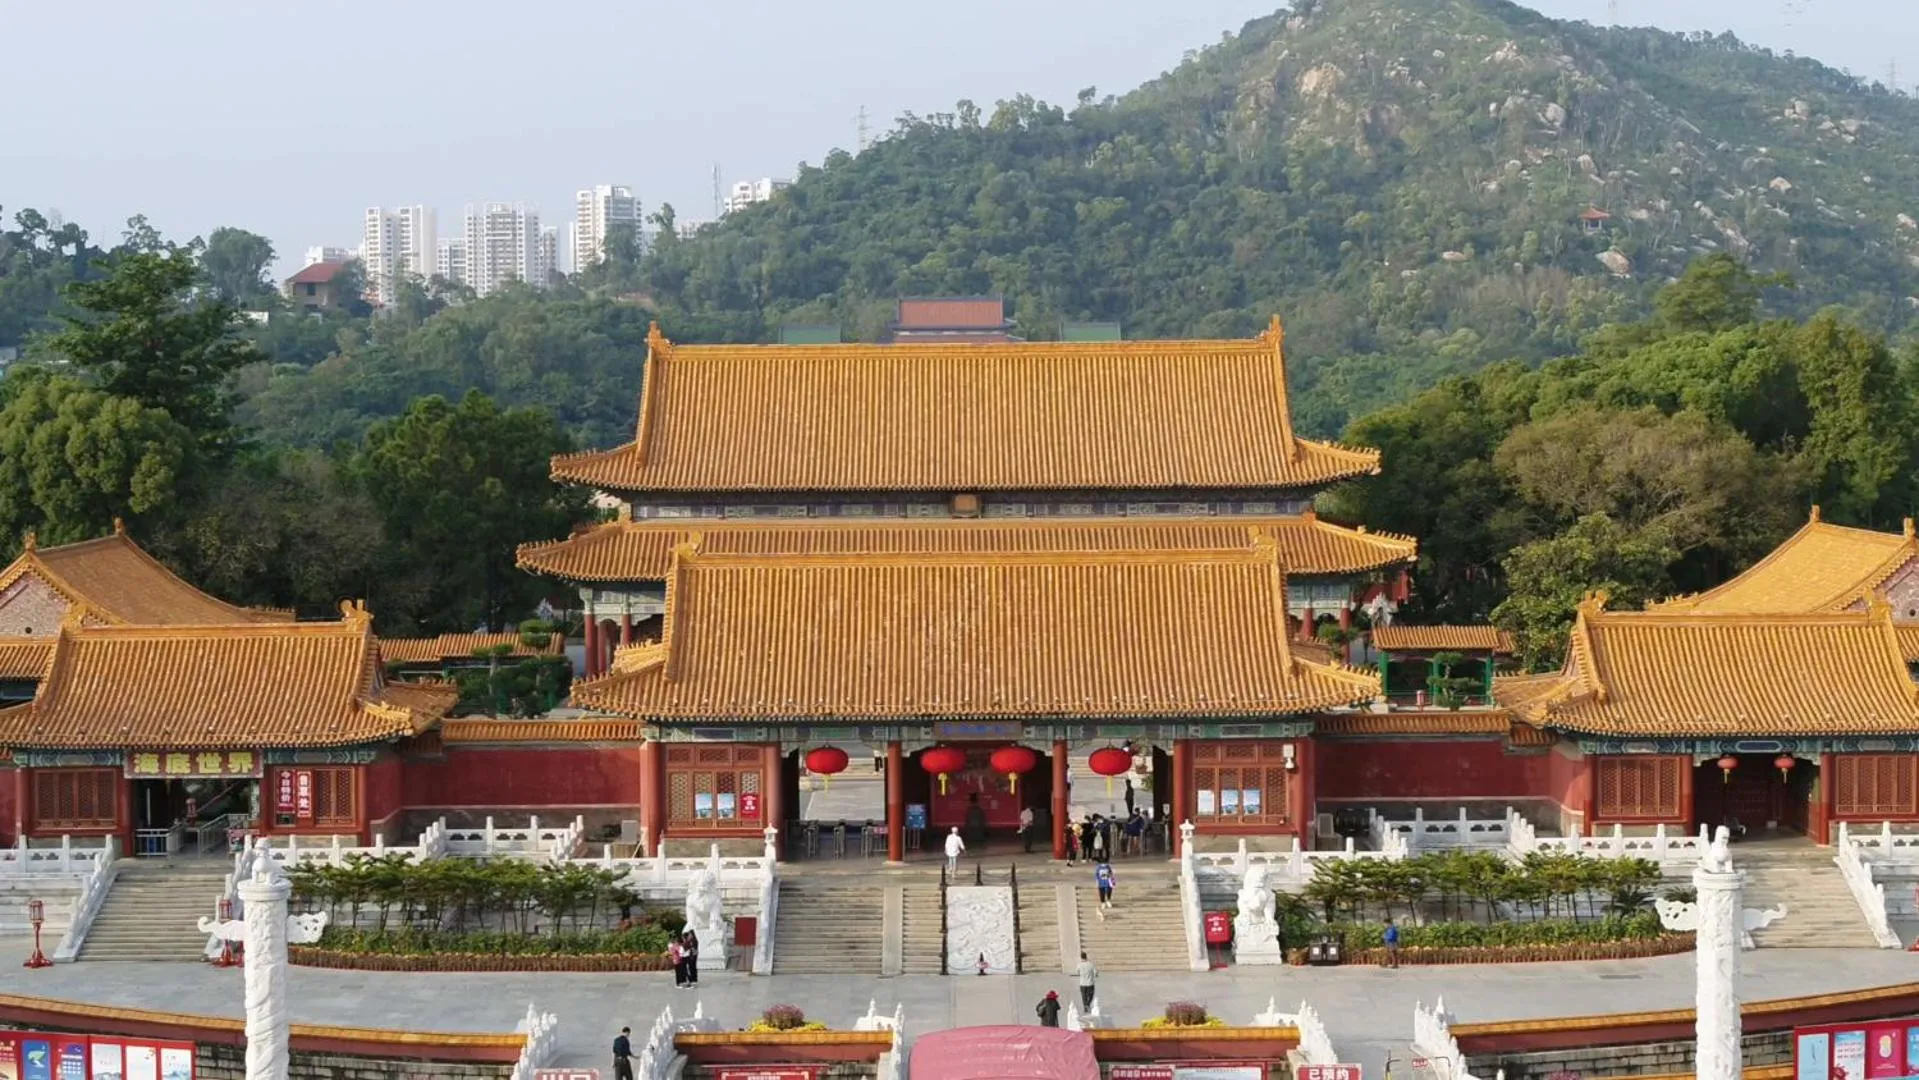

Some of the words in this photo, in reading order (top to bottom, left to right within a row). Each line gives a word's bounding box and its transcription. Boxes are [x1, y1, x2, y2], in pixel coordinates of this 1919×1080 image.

[134, 752, 253, 774] 海底世界
[1309, 1068, 1350, 1080] 已预约
